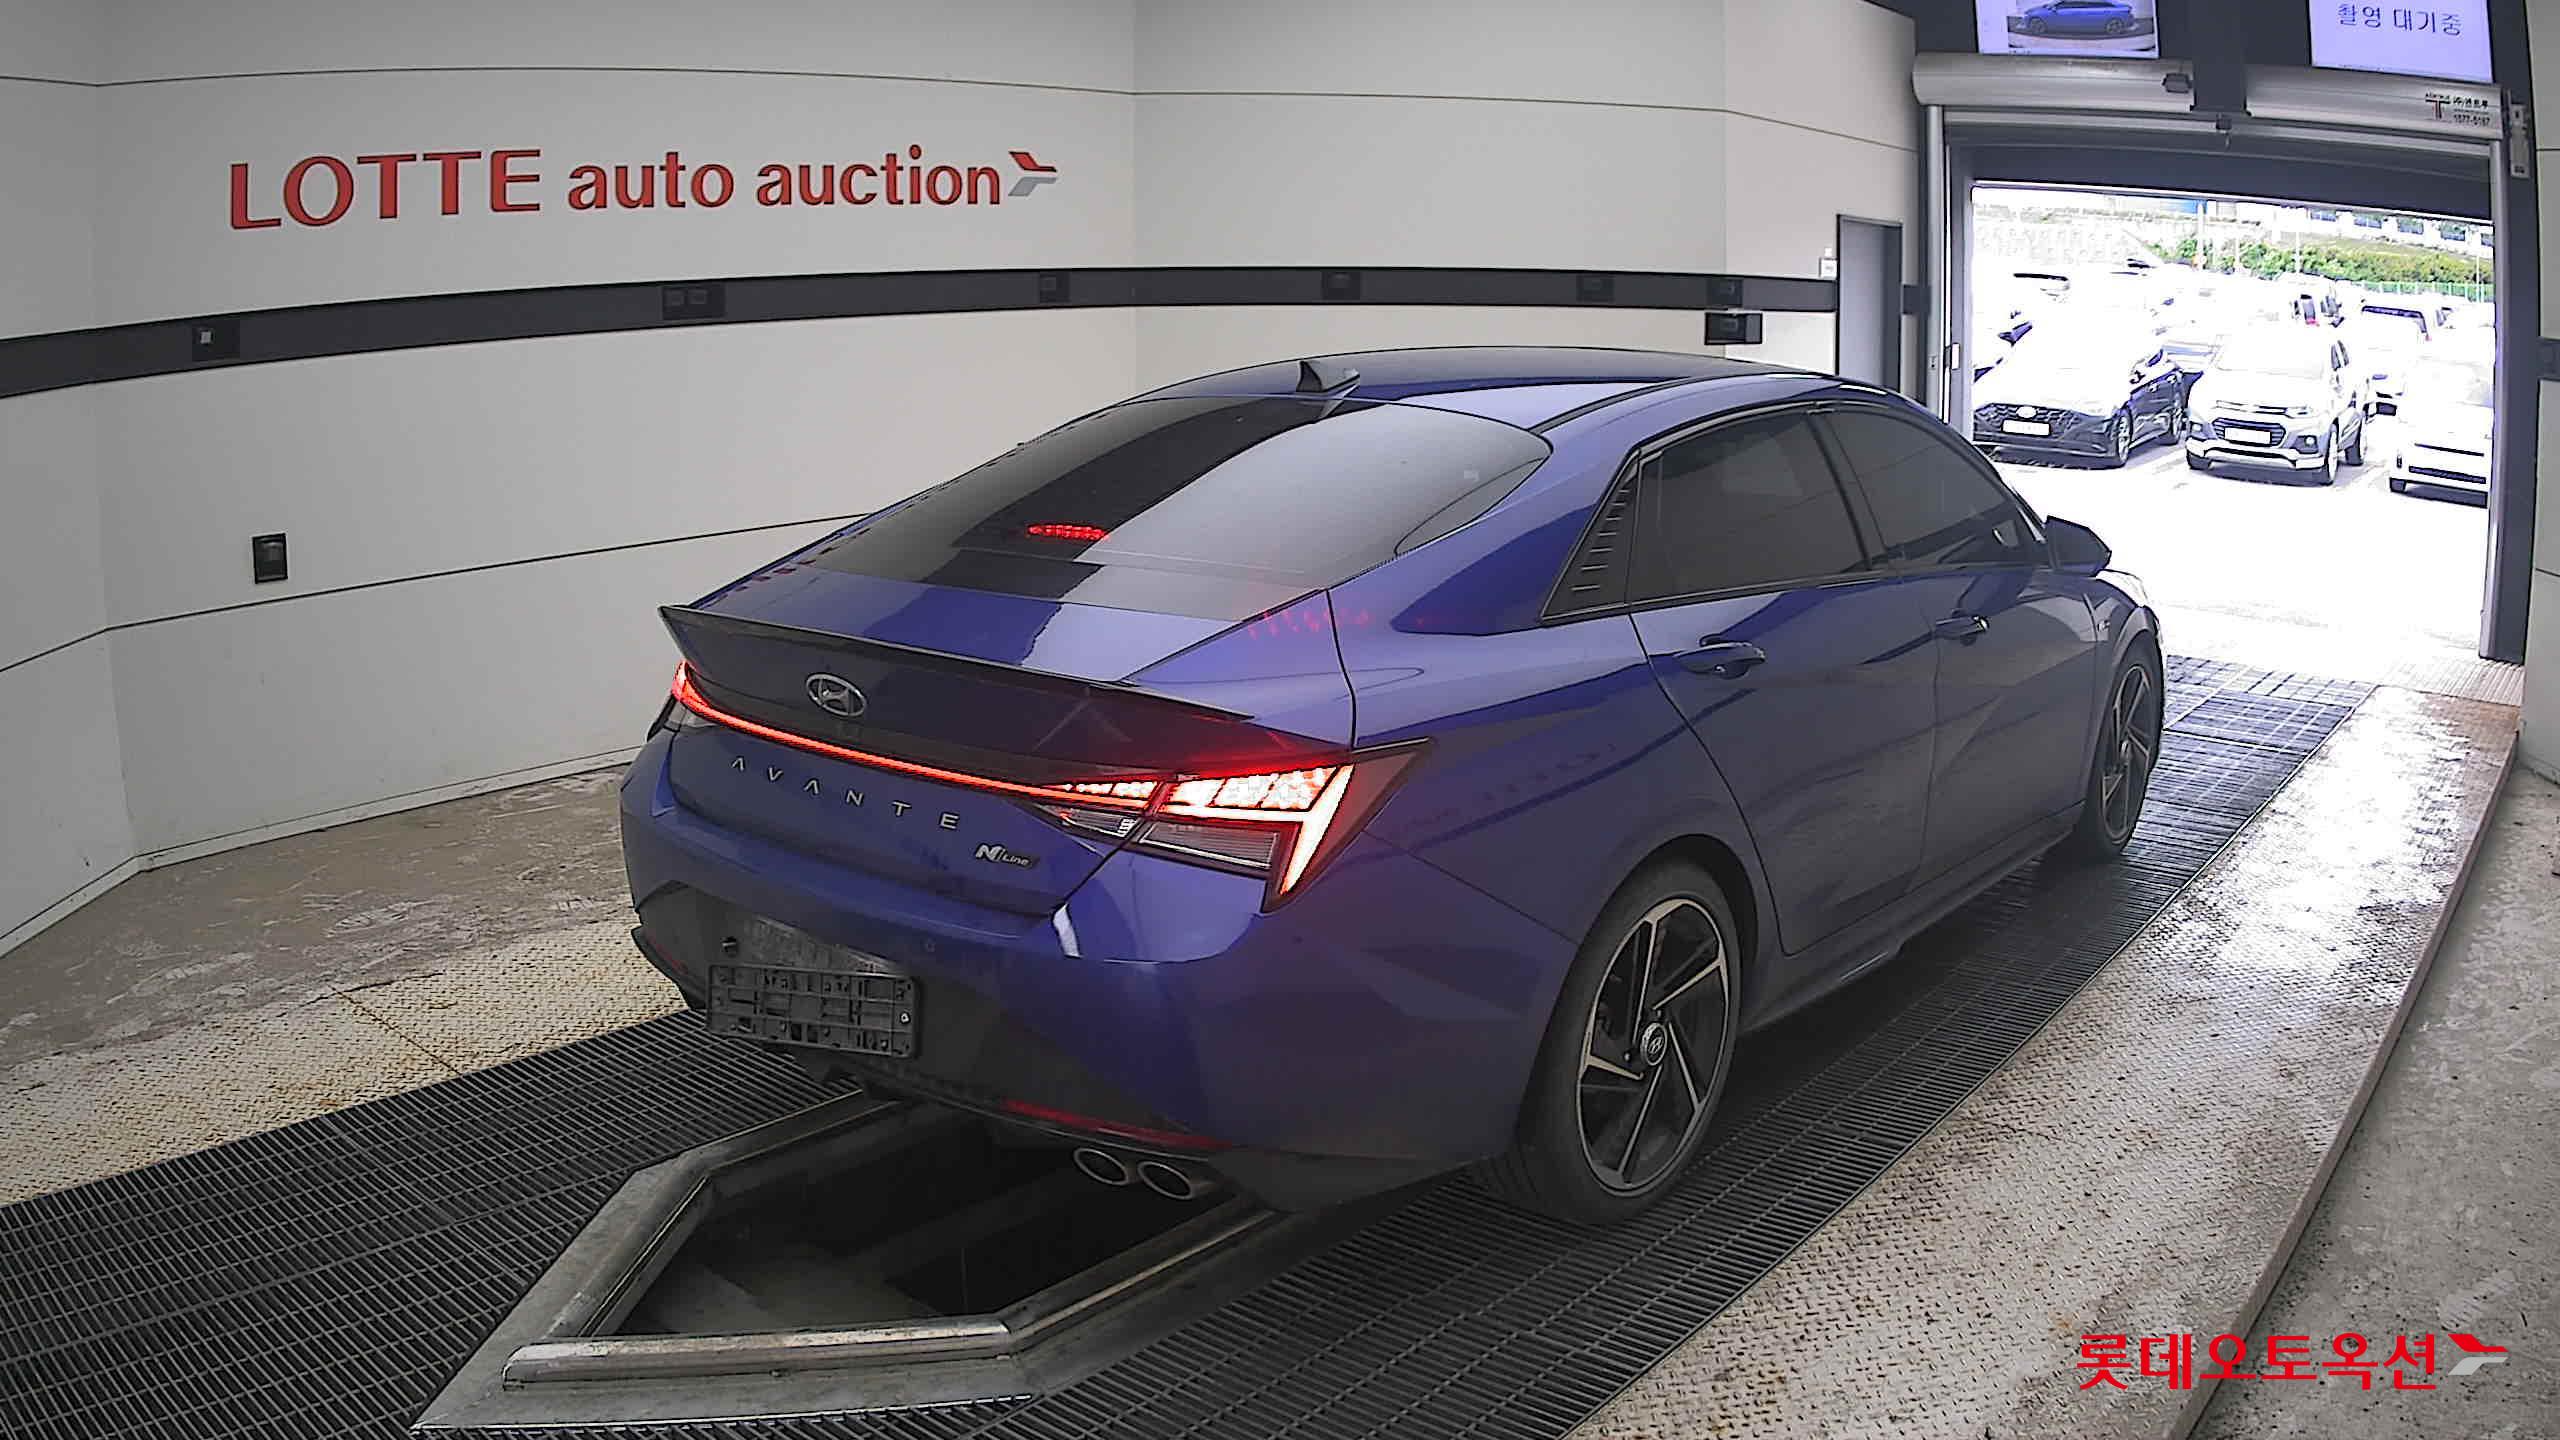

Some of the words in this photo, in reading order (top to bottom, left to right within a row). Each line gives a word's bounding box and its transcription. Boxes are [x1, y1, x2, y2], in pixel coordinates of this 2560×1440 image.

[2337, 4, 2382, 28] 촬영
[230, 149, 541, 230] LOTTE
[568, 151, 735, 209] auto
[756, 145, 1000, 206] auction
[730, 756, 960, 830] AVANTE
